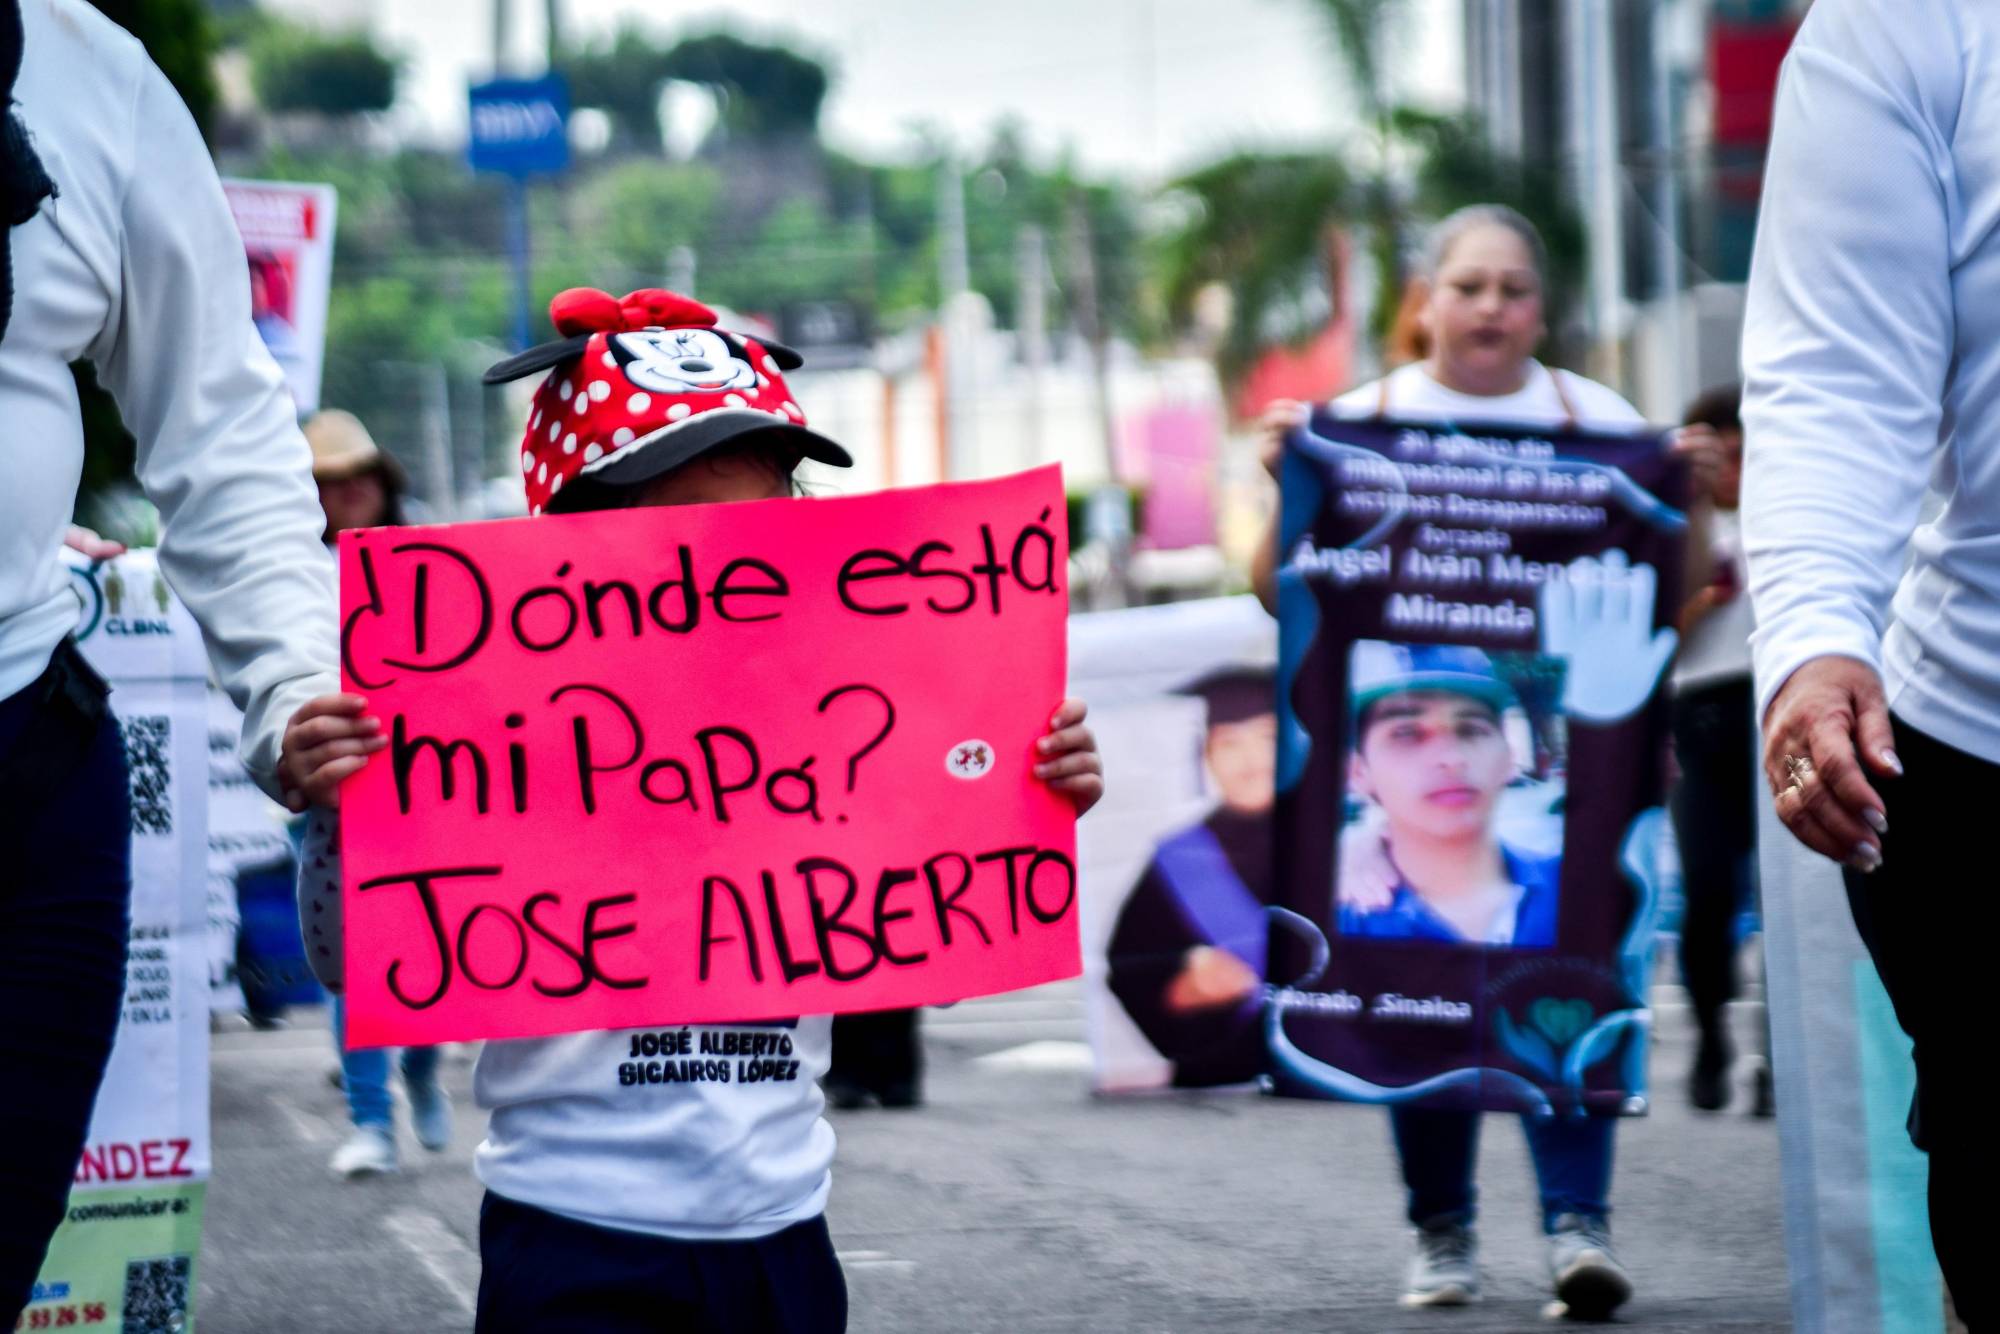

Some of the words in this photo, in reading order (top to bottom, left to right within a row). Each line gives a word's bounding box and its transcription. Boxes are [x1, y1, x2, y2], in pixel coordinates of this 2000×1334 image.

[837, 506, 1060, 616] está
[1293, 532, 1391, 583] Ángel
[1405, 546, 1482, 578] Iván
[1388, 592, 1535, 629] Miranda
[391, 712, 527, 815] mi
[698, 846, 1077, 984] ALBERTO
[629, 1025, 694, 1058] JOSÉ
[699, 1031, 794, 1057] ALBERTO
[618, 1059, 731, 1086] SICAIROS
[738, 1054, 800, 1083] LÓPEZ
[73, 1138, 193, 1183] NDEZ
